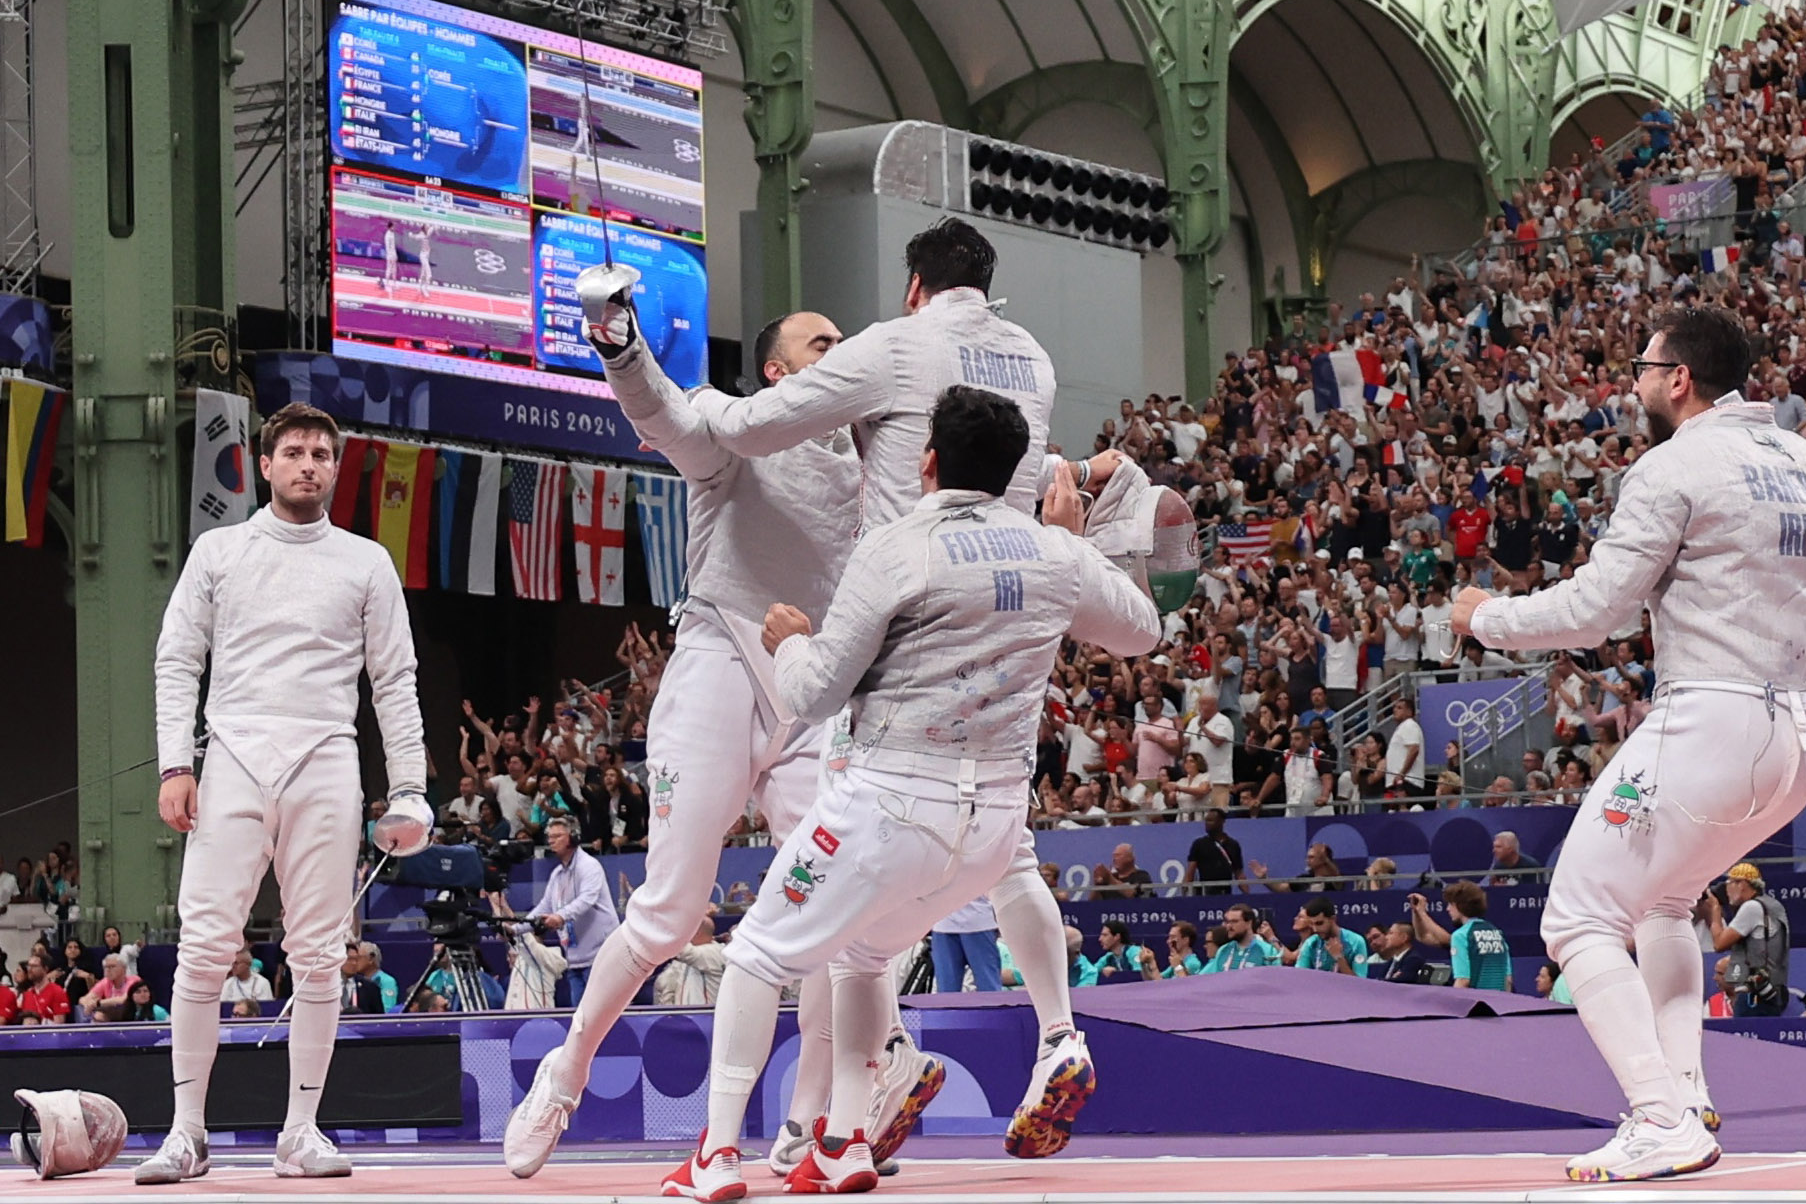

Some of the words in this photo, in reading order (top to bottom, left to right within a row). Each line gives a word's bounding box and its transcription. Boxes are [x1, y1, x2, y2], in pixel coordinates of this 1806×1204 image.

[340, 2, 370, 20] SABRE
[370, 10, 390, 25] PAR
[434, 26, 477, 47] HOMMES
[566, 411, 616, 437] 2024
[992, 570, 1024, 612] IRI
[1142, 911, 1176, 924] 2024
[1342, 903, 1379, 915] 2024
